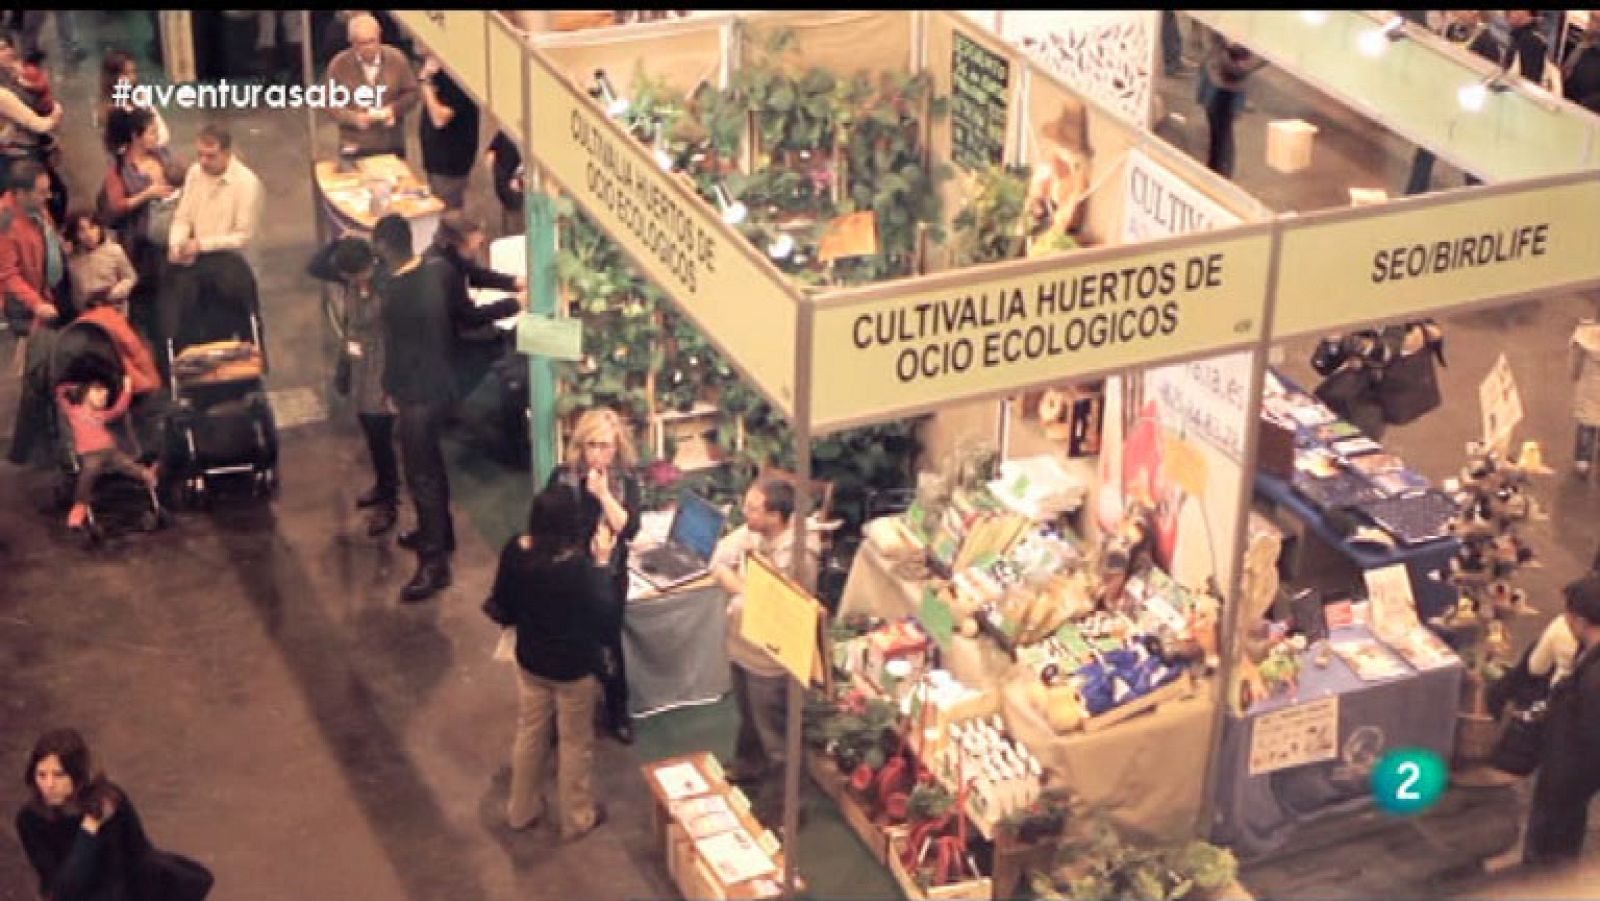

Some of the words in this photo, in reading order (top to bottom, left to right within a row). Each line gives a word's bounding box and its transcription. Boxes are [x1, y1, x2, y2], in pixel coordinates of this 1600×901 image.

[587, 161, 614, 211] OCIO
[616, 189, 696, 293] ECOLOGICOS
[635, 171, 694, 252] HUERTOS
[697, 226, 715, 272] DE
[1131, 166, 1212, 233] CULTIV
[1372, 223, 1549, 284] SEO/BIRDLIFE
[853, 288, 1026, 349] CULTIVALIA
[1037, 262, 1176, 316] HUERTOS
[1185, 254, 1223, 291] DE
[896, 336, 974, 382] OCIO
[983, 301, 1178, 367] ECOLOGICOS
